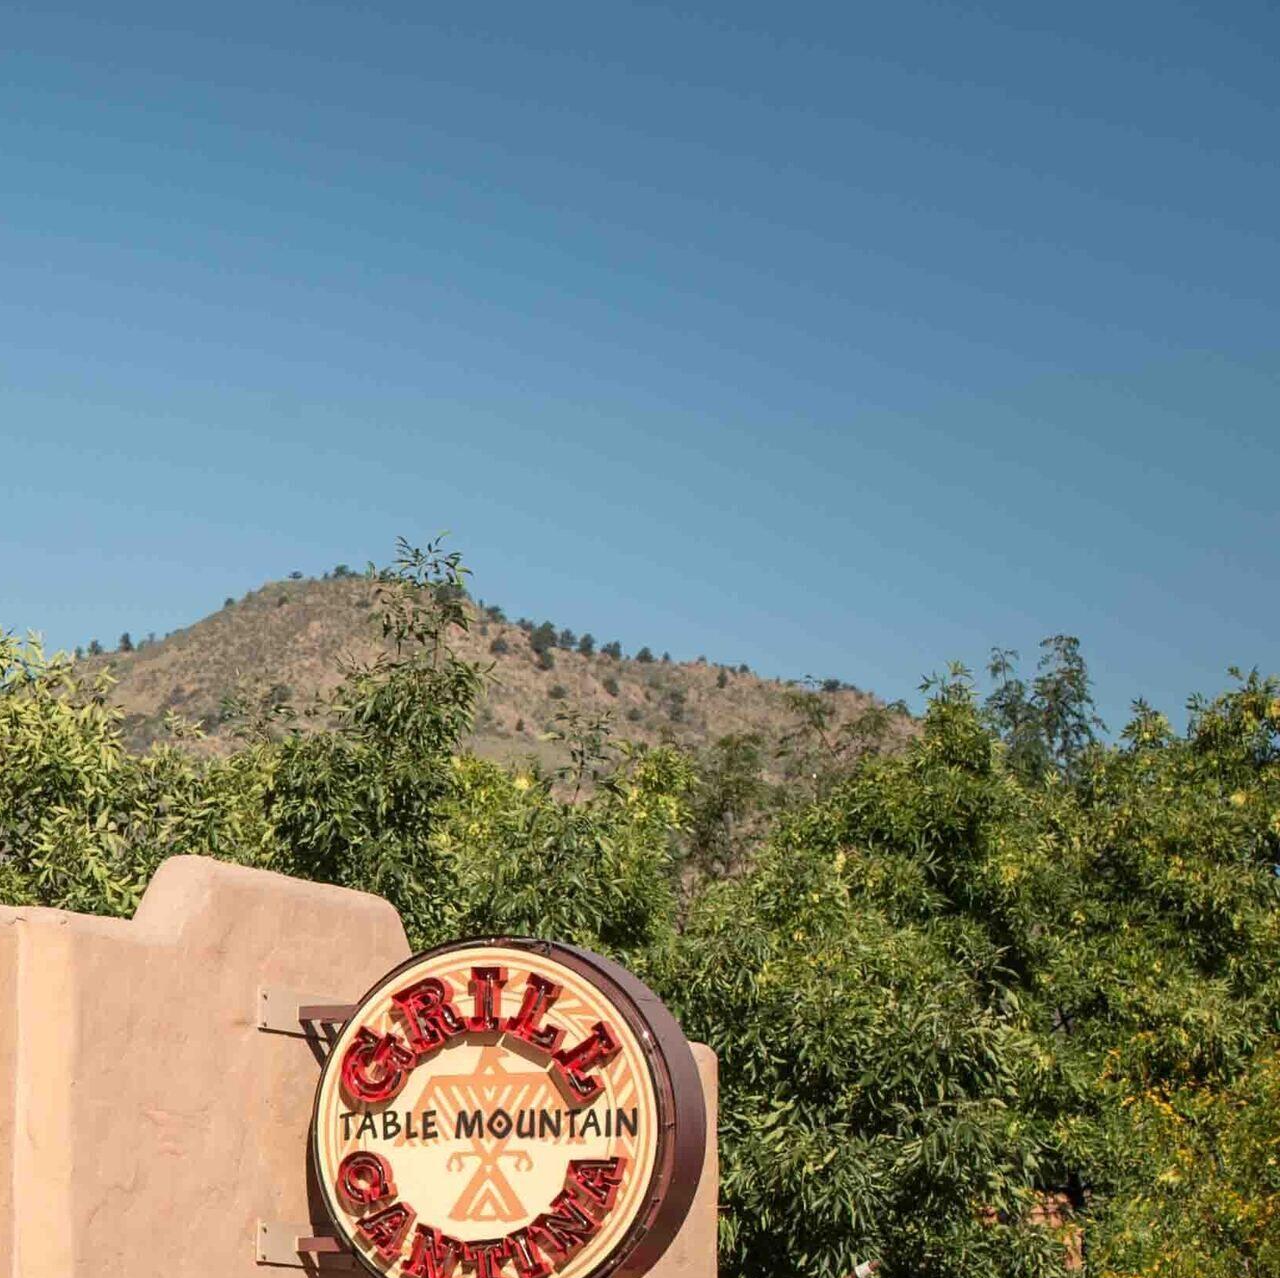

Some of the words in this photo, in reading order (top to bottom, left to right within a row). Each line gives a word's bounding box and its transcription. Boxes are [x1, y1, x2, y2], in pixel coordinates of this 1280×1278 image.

[342, 966, 623, 1102] GRILL
[340, 1108, 438, 1141] TABLE
[454, 1107, 639, 1140] MOUNTAIN
